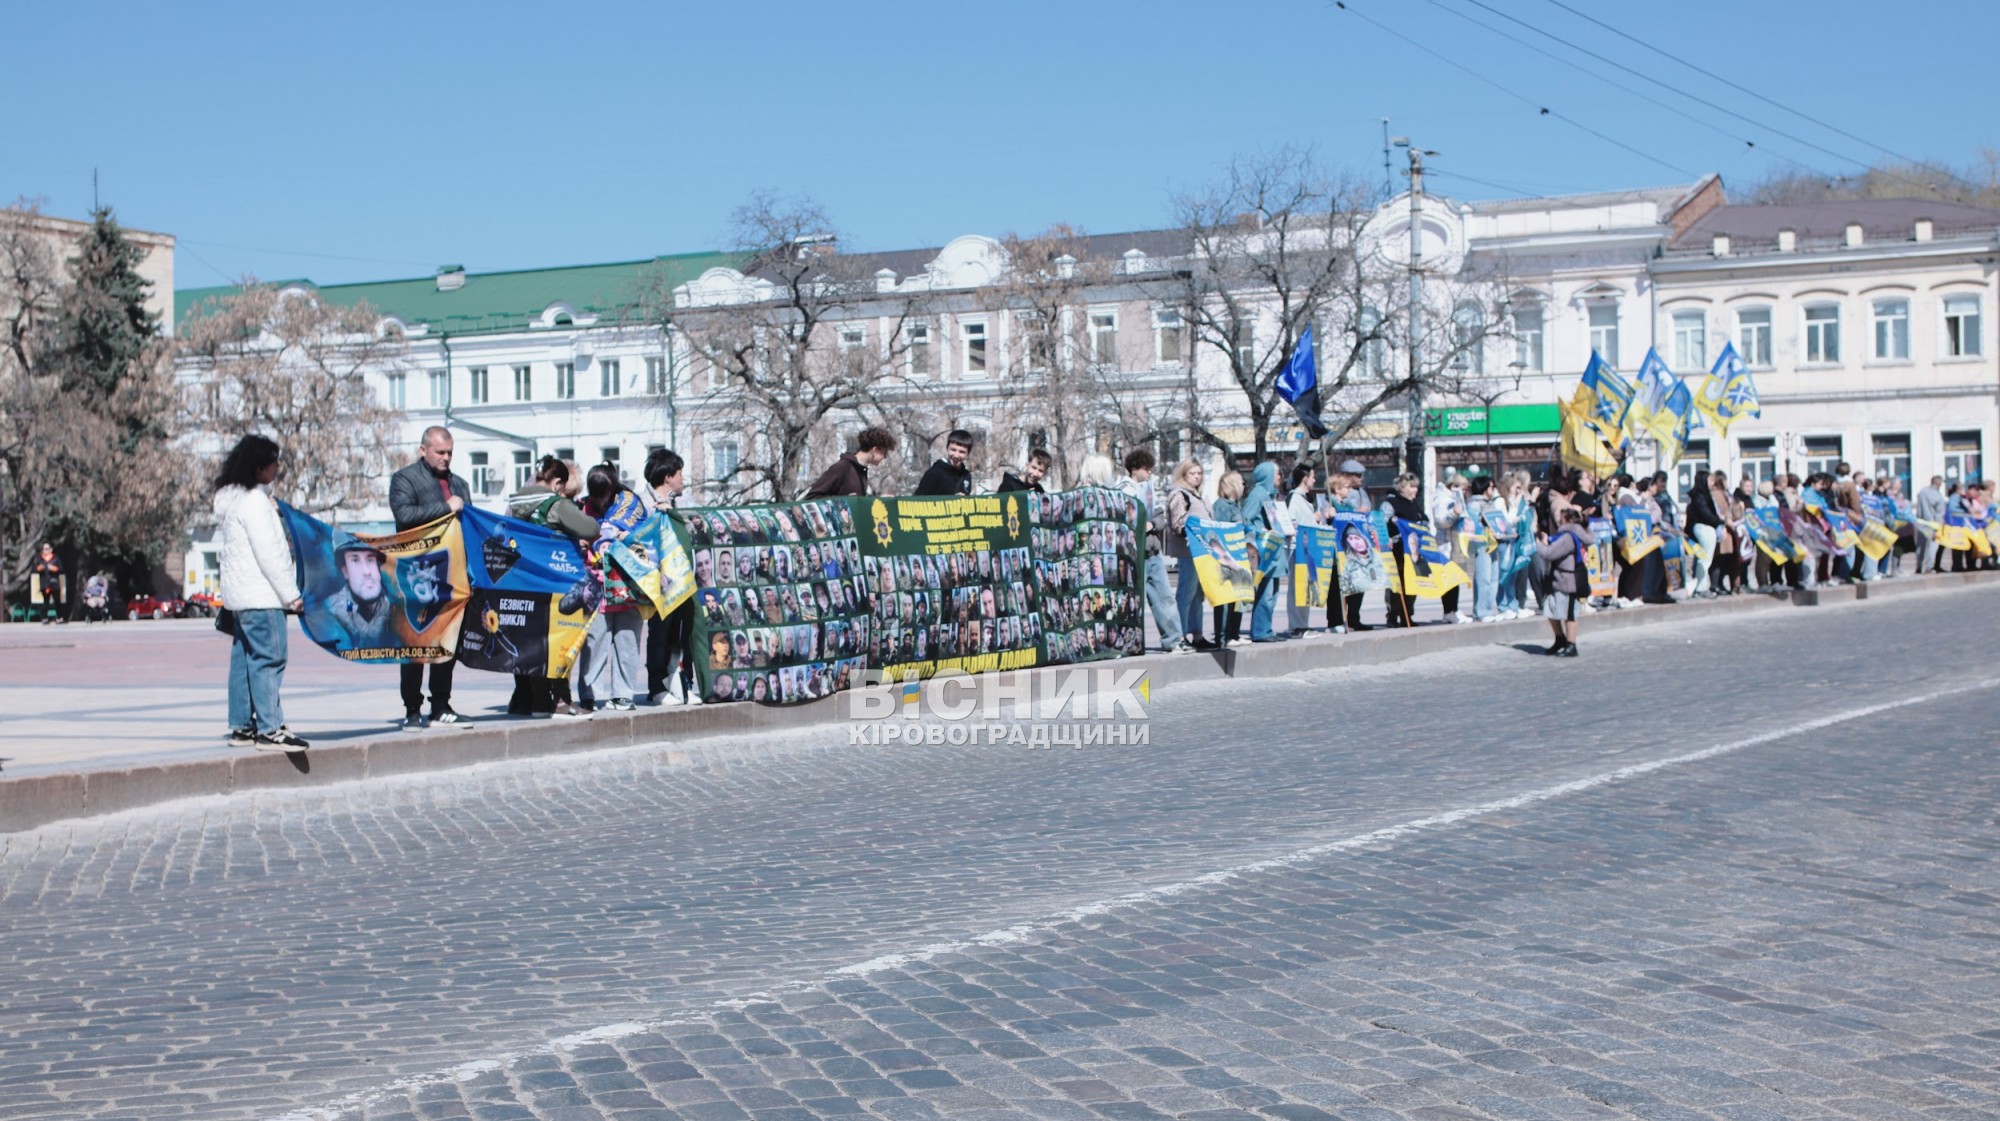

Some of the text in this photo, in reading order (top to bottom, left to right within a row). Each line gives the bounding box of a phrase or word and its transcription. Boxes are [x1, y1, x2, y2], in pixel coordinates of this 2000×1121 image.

[1448, 411, 1486, 421] master
[1448, 421, 1468, 430] zoo
[551, 550, 568, 562] 42
[499, 598, 535, 612] БЕЗВІСТИ
[498, 613, 526, 627] ЗНИКЛІ
[360, 648, 394, 660] БЕЗВІСТИ
[400, 647, 442, 659] 24.08.20
[999, 646, 1037, 672] ДОДОМУ
